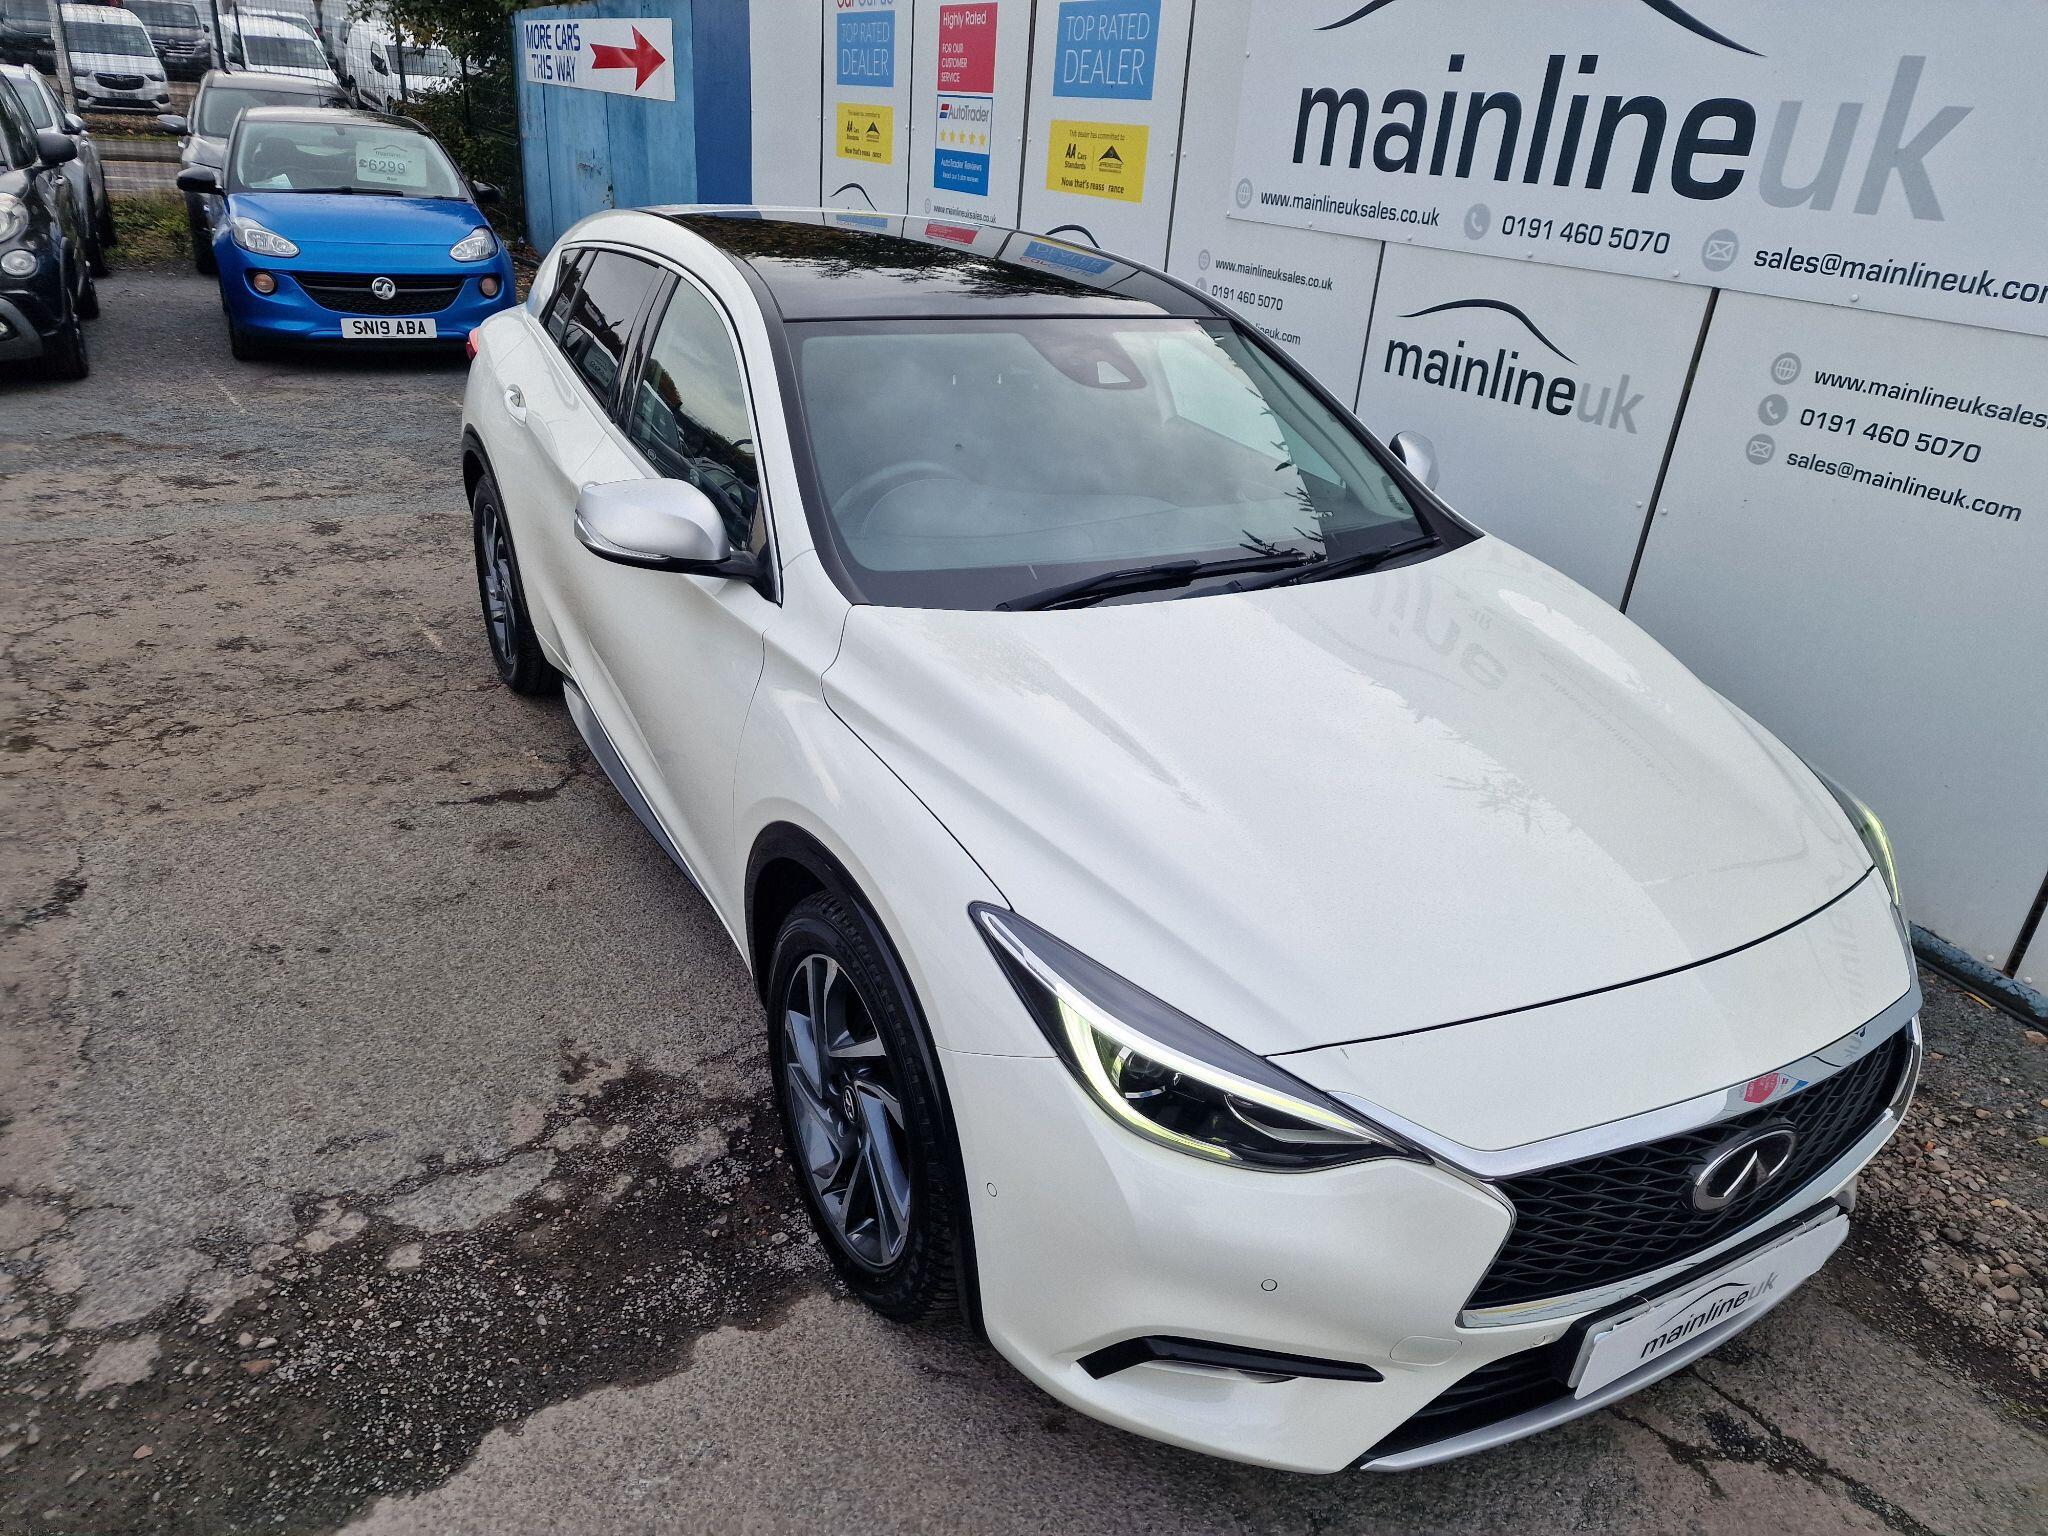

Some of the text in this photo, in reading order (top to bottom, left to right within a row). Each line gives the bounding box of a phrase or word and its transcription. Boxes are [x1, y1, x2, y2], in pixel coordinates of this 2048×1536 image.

[841, 22, 890, 43] TOP RATED
[943, 10, 987, 30] Highly Rated
[1065, 12, 1150, 41] TOP RATED
[526, 24, 581, 51] MORE CARS
[942, 43, 964, 54] FOR OUR
[531, 53, 576, 83] THIS WAY
[842, 48, 889, 76] DEALER
[941, 57, 968, 69] CUSTOMER
[1063, 48, 1145, 86] DEALER
[941, 72, 960, 83] SERVICE
[947, 104, 990, 123] AutoTrader
[1065, 143, 1077, 159] AA
[1292, 54, 1974, 222] mainlineuk
[1060, 177, 1073, 187] Now
[1074, 178, 1089, 190] that's
[1260, 191, 1441, 227] www.mainlineuksales.co.uk
[1501, 215, 1671, 254] 0191 460 5070
[1215, 258, 1334, 291] www.mainlineuksales.co.uk
[1211, 284, 1284, 311] 0191 460 5070
[352, 320, 427, 335] SN19 ABA
[1384, 338, 1645, 435] mainlineuk
[1800, 408, 1983, 465] 0191 460 5070
[1786, 452, 2023, 522] sales@mainlineuk.com
[1640, 1271, 1780, 1360] mainlineuk
